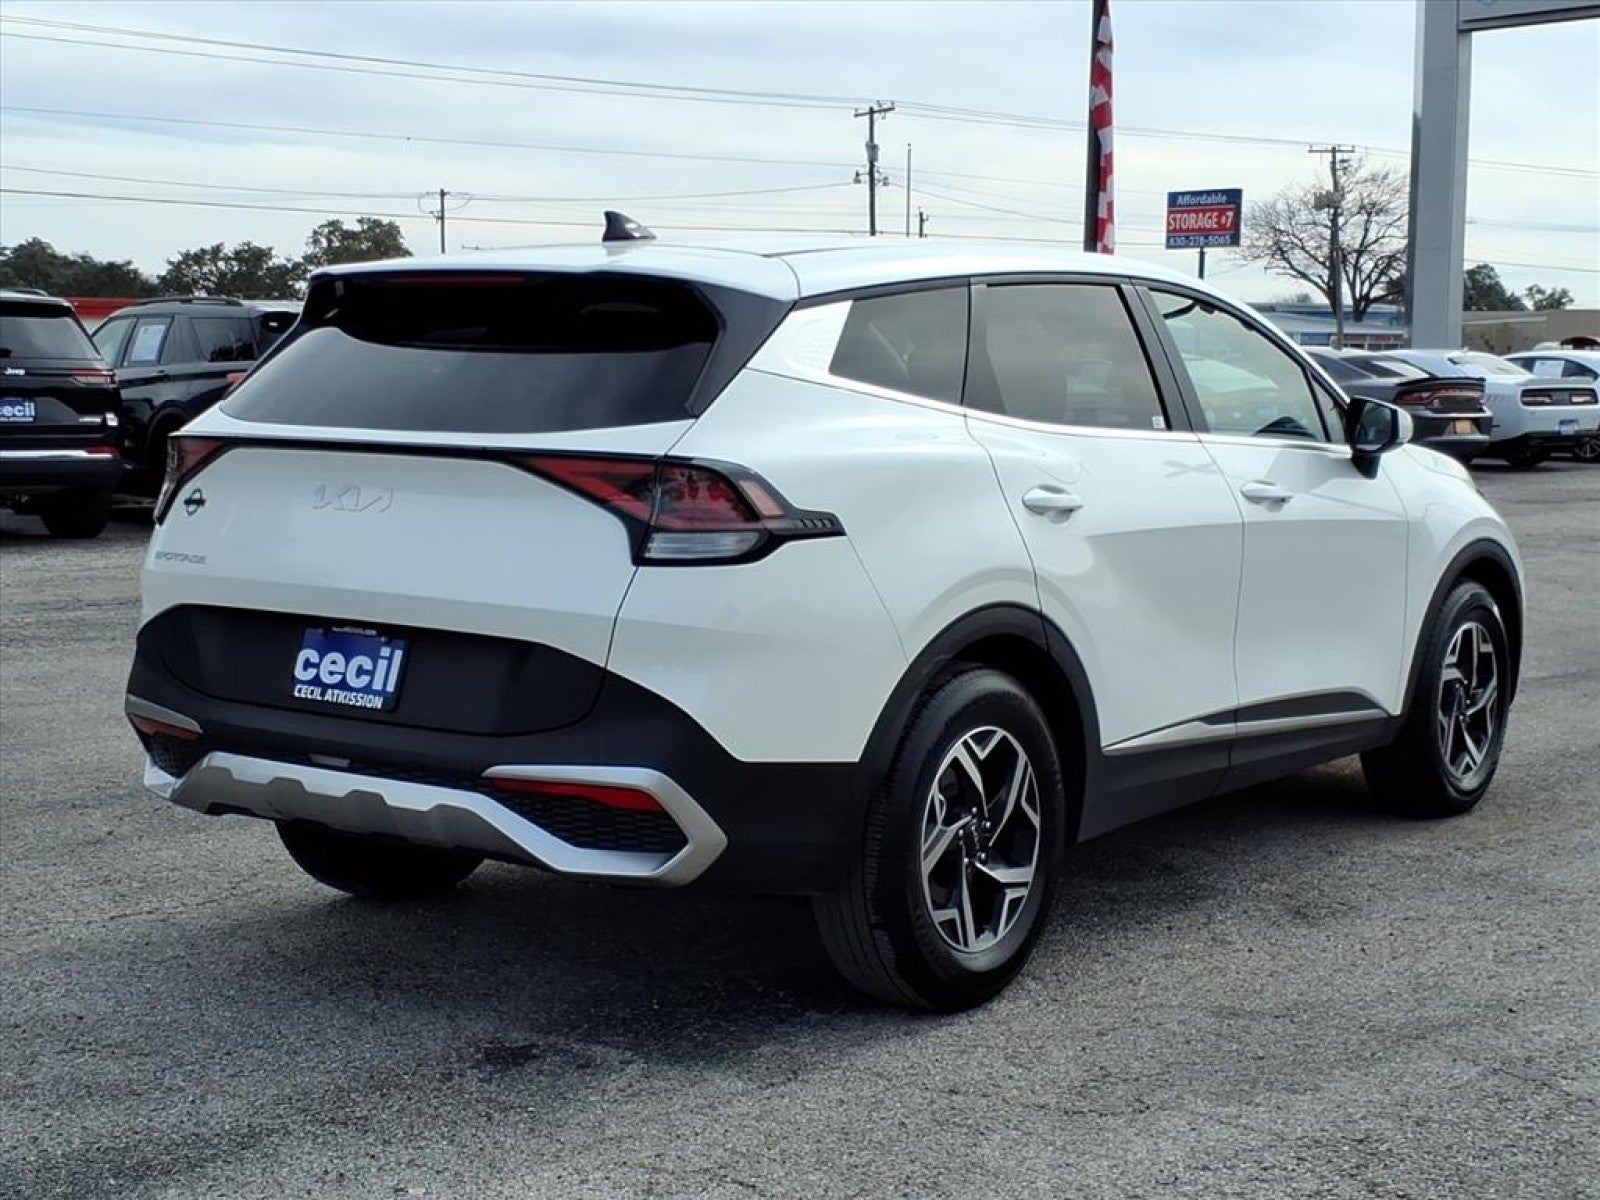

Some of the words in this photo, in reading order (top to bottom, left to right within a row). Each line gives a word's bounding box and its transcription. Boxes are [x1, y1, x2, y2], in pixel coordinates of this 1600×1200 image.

[1177, 194, 1227, 205] Affordable
[1168, 213, 1218, 230] STORAGE
[312, 484, 394, 513] KIA
[294, 646, 403, 692] cecil
[294, 683, 323, 701] CECIL
[324, 688, 384, 709] ATKISSION
